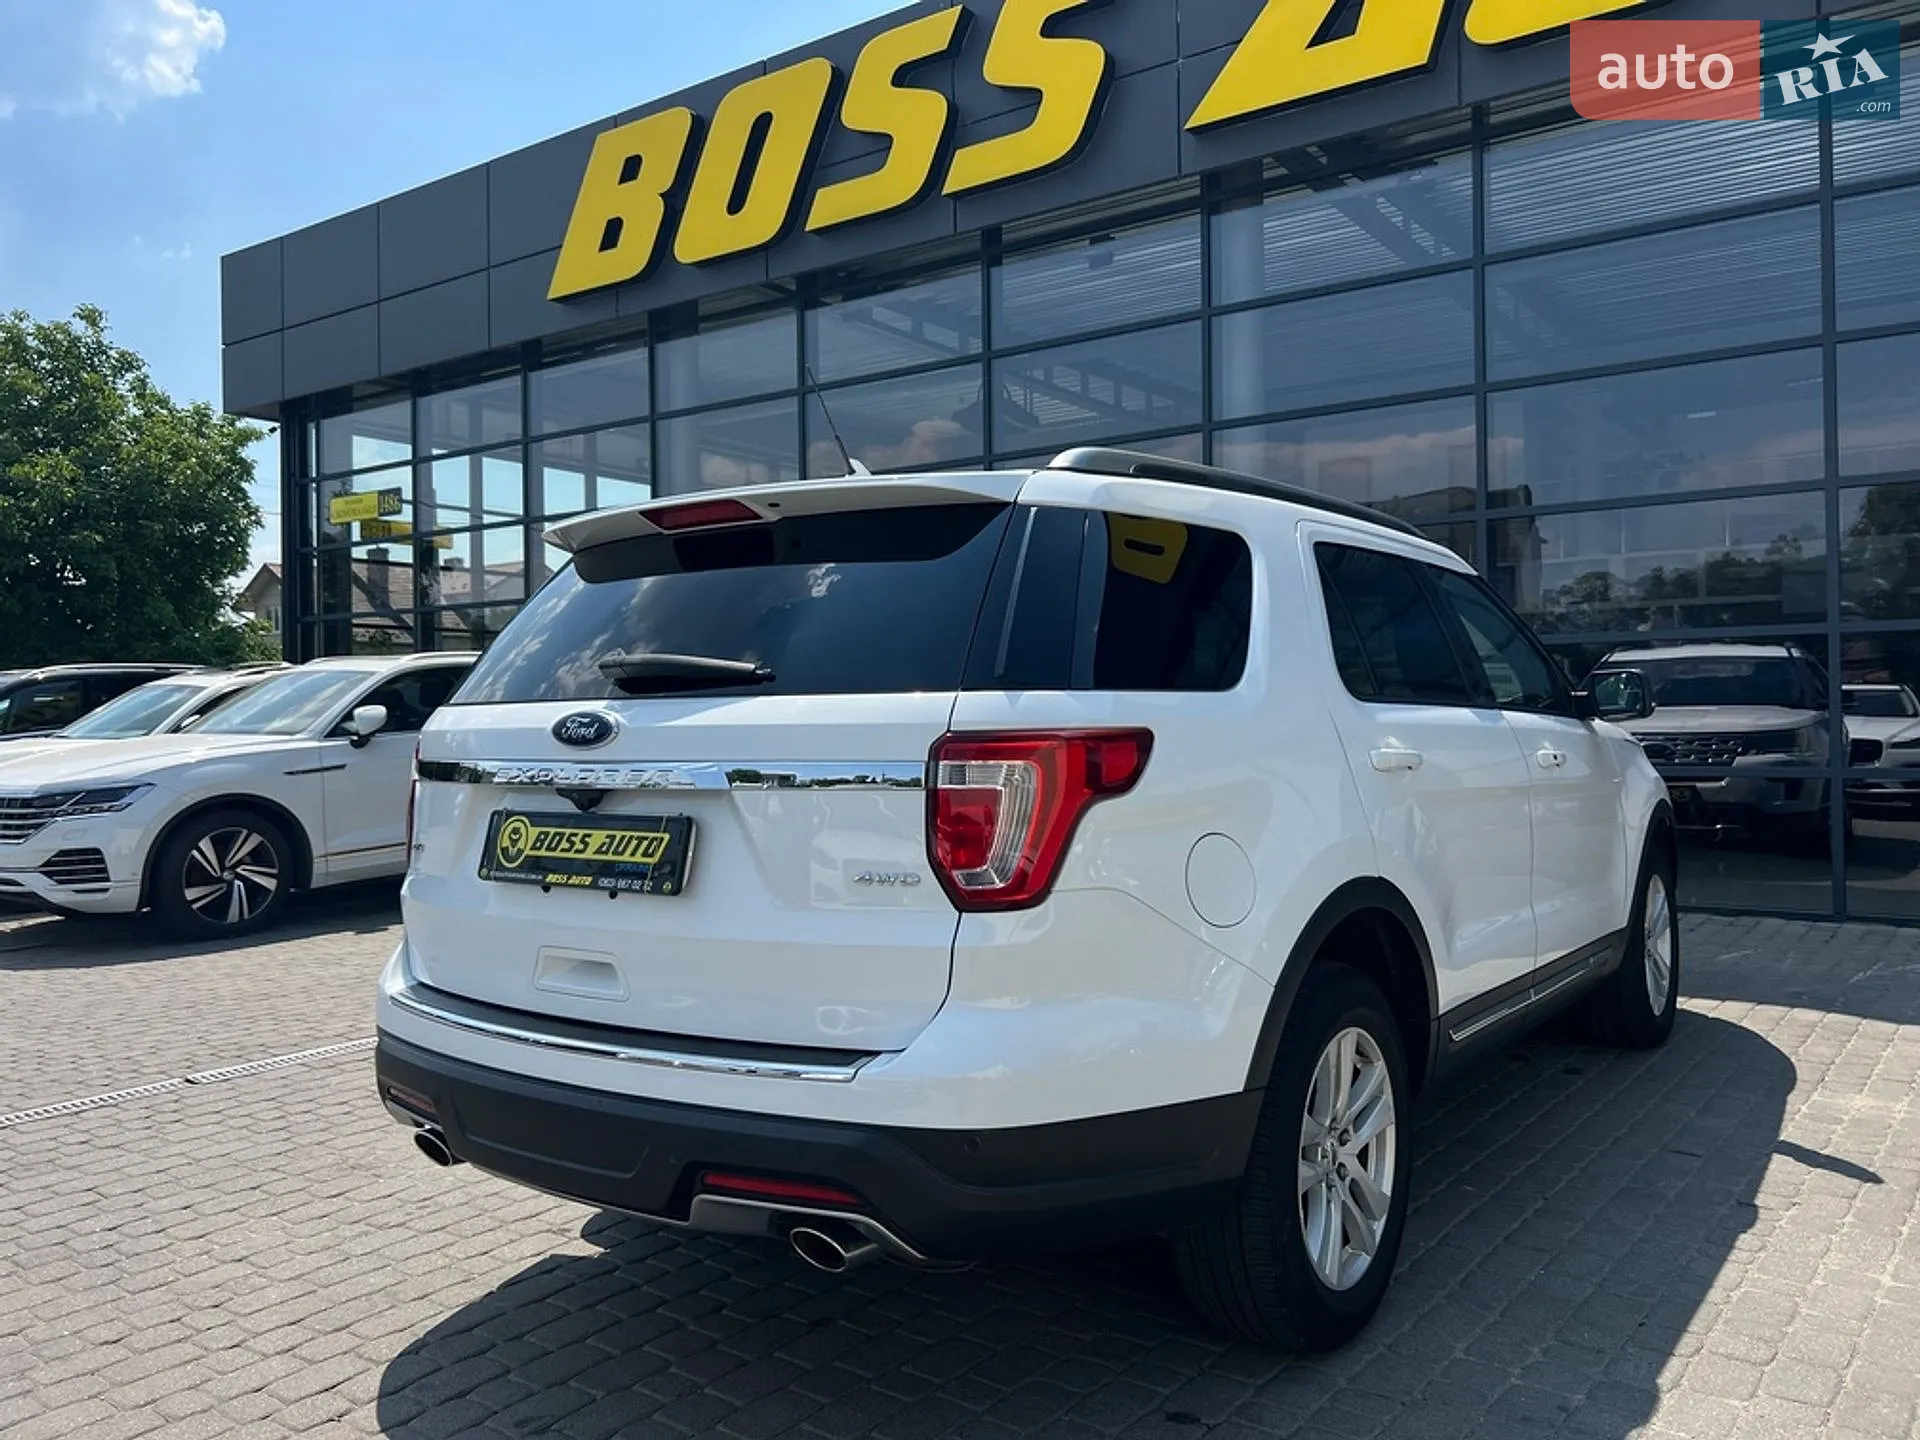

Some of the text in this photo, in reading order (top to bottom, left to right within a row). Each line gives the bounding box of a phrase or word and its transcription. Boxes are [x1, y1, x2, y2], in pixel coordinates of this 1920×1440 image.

[547, 0, 1107, 299] BOSS
[561, 716, 600, 740] Ford
[529, 830, 665, 858] BOSS AUTO
[545, 873, 568, 884] BOSS
[567, 874, 593, 886] AUTO
[852, 870, 921, 887] 4WD
